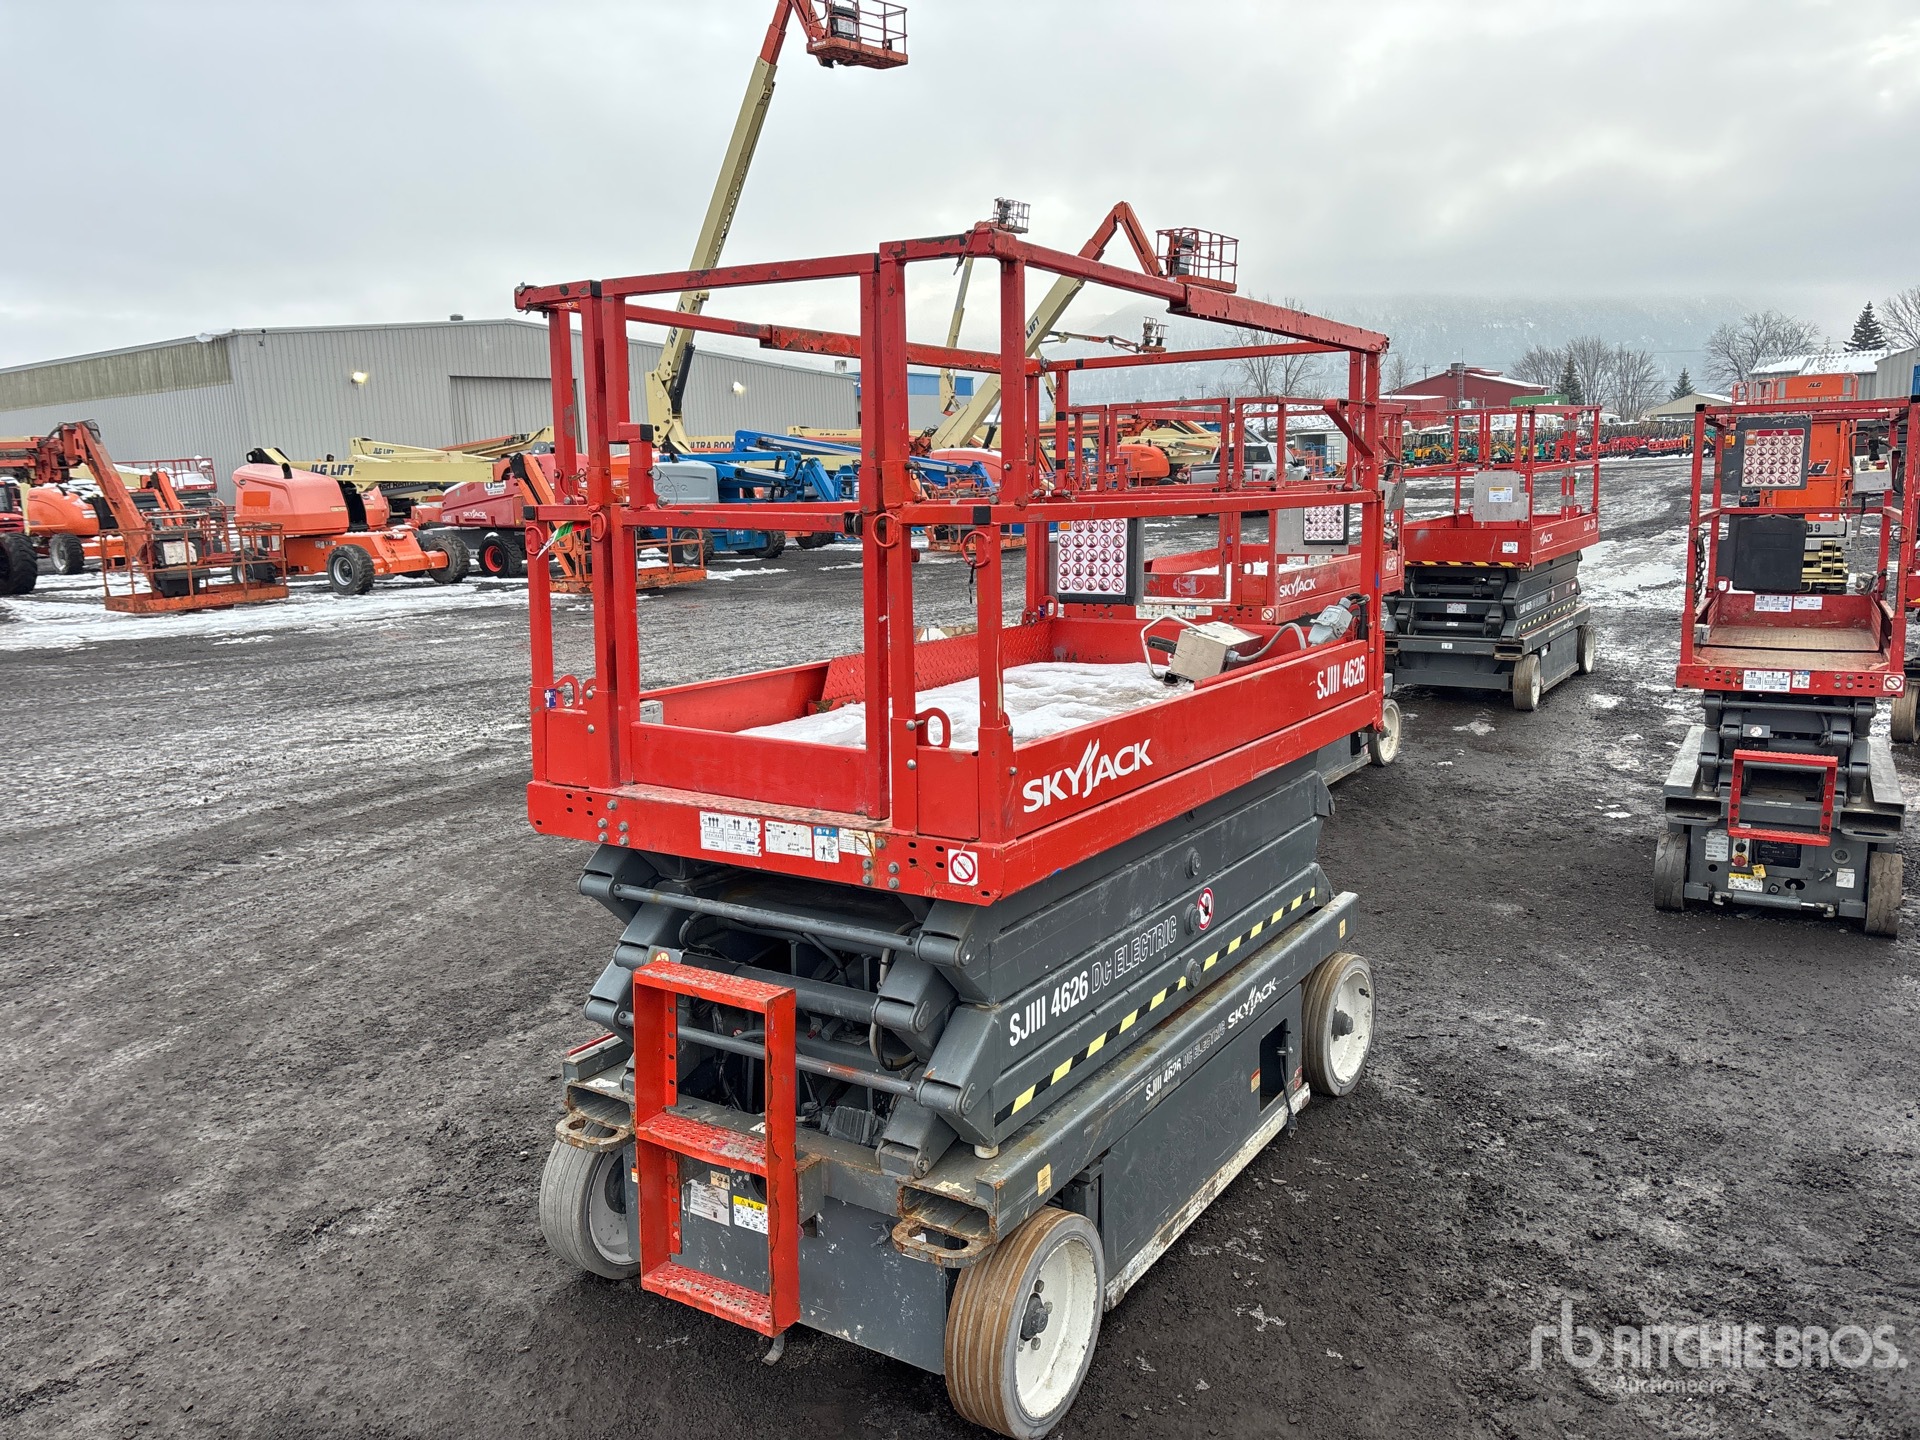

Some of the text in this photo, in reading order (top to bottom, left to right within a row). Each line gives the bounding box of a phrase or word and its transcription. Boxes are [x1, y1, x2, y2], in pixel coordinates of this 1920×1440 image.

[1025, 315, 1040, 339] LIFT
[373, 447, 394, 455] JLG LIFT
[310, 464, 354, 476] JLG LIFT
[463, 509, 487, 519] SKYJACK
[1279, 575, 1316, 598] SKYJACK
[1342, 654, 1366, 689] 4626
[1022, 737, 1154, 814] SKYJACK
[1050, 970, 1089, 1019] 4626
[1114, 915, 1177, 980] ELECTRIC
[1163, 1057, 1182, 1084] 4626
[1193, 1019, 1227, 1060] ELECTRIC
[1227, 976, 1278, 1030] SKYJACK
